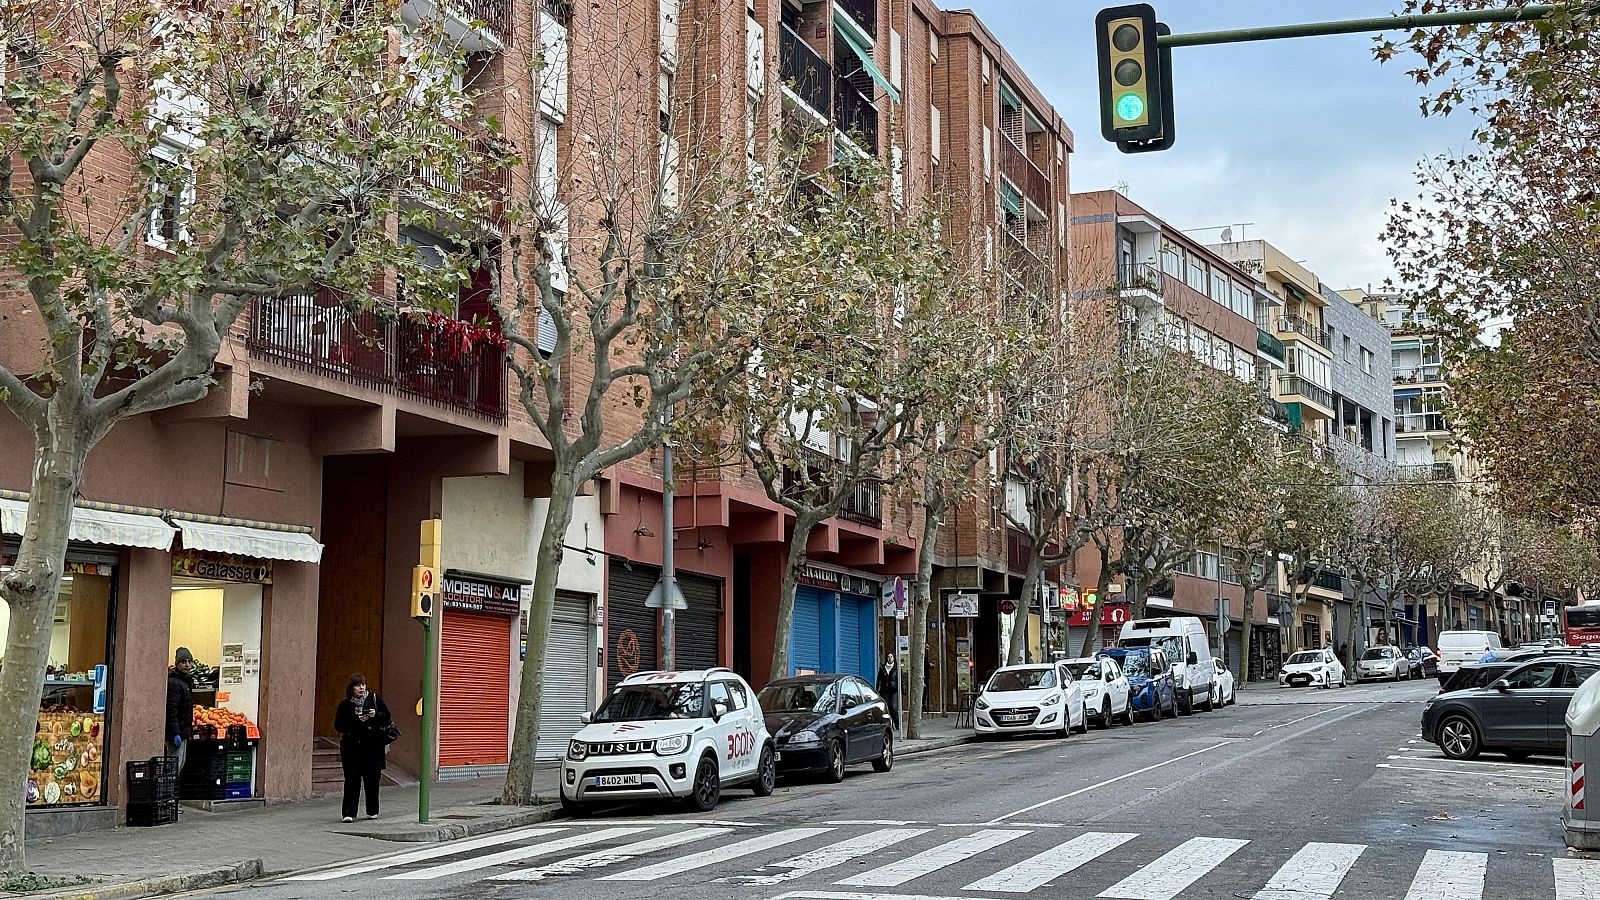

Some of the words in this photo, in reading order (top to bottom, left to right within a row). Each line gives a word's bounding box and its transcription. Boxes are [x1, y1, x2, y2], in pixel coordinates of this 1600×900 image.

[444, 579, 493, 599] MOBEEN
[493, 586, 501, 600] &
[502, 587, 519, 602] ALI
[444, 592, 483, 605] LOCUTORI
[1571, 633, 1600, 641] Saga
[601, 776, 622, 786] 8402
[623, 775, 640, 785] MNL
